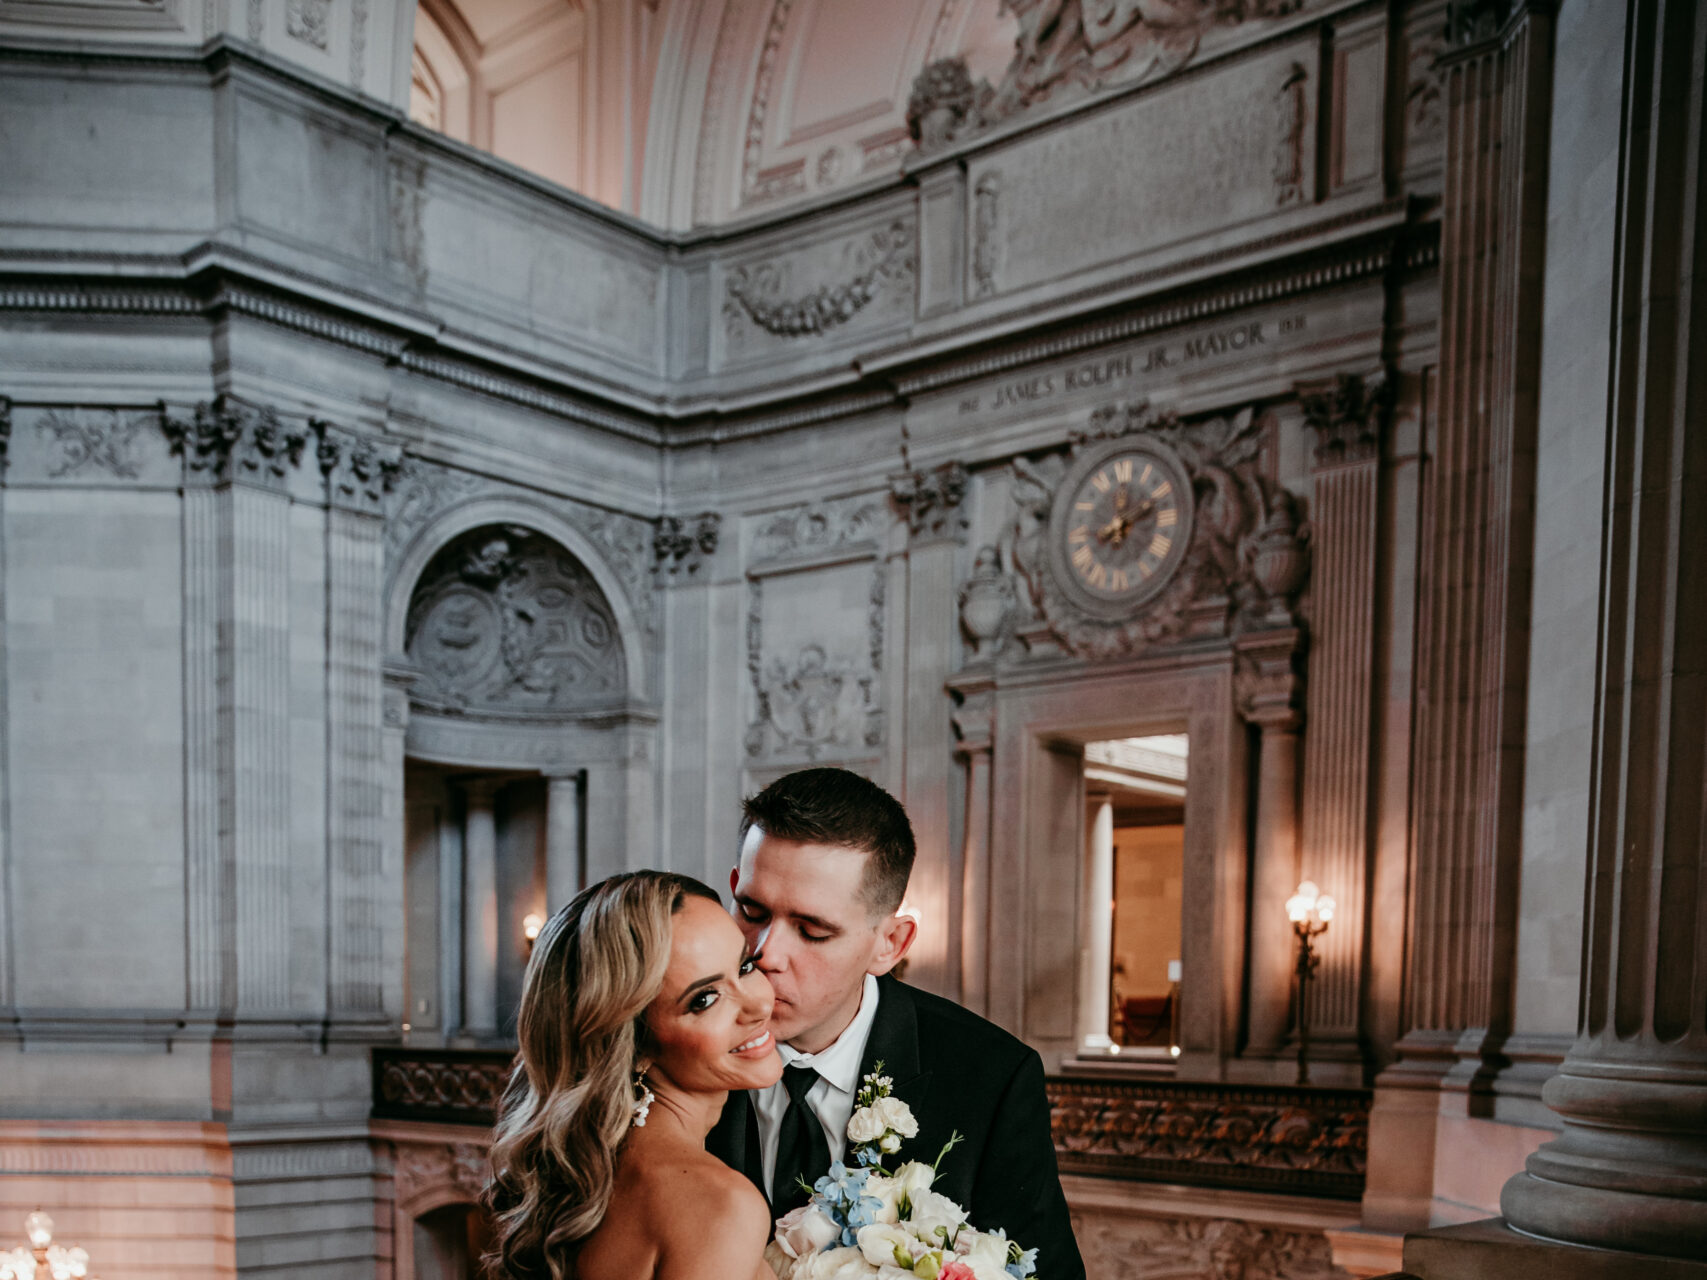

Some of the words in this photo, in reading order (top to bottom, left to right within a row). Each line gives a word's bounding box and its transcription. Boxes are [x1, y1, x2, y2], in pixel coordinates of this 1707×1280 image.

[990, 374, 1053, 410] JAMES
[1065, 354, 1133, 392] ROLPH
[1184, 322, 1264, 359] MAYOR
